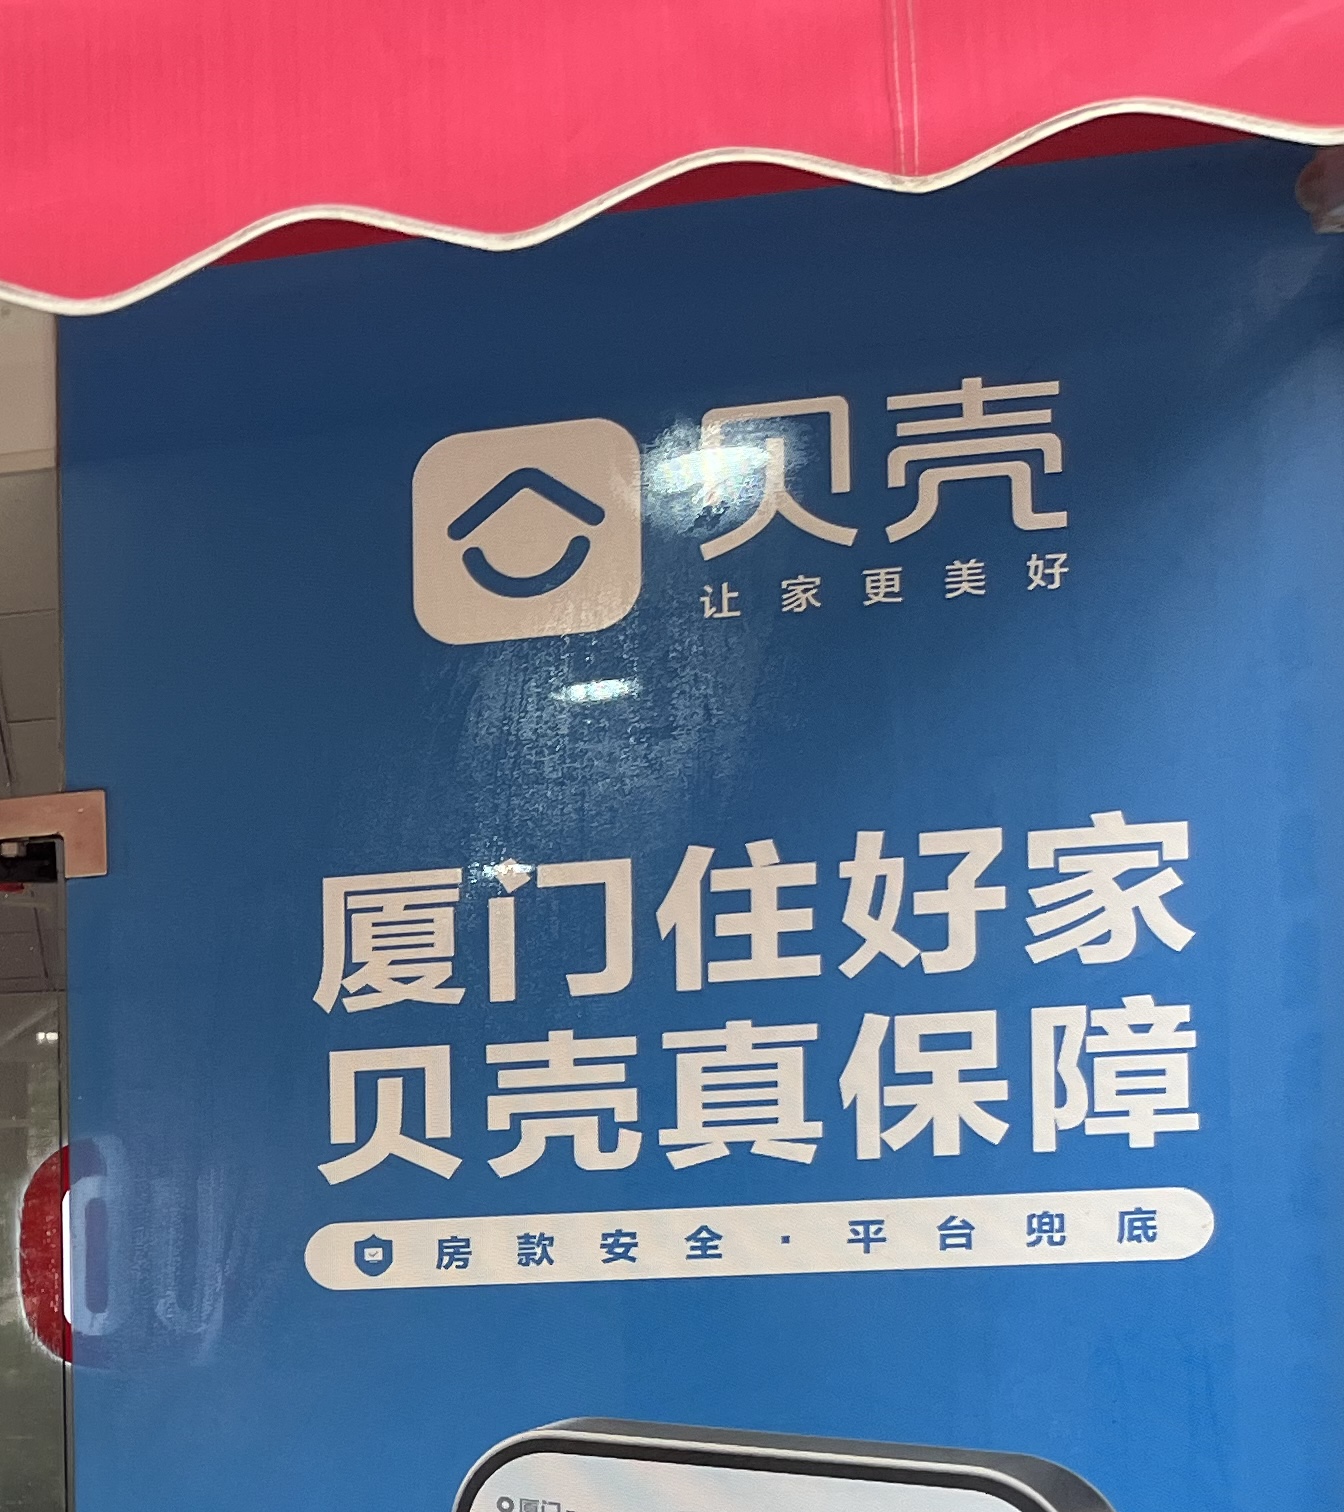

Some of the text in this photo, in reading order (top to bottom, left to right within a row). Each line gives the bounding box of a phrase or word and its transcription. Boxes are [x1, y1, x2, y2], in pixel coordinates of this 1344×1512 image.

[700, 377, 1070, 560] 贝壳
[700, 553, 1072, 620] 让家更美好
[311, 811, 1196, 1014] 厦门住好家
[315, 994, 1200, 1186] 贝壳真保障
[433, 1203, 1161, 1271] 房款安全·平台兜底
